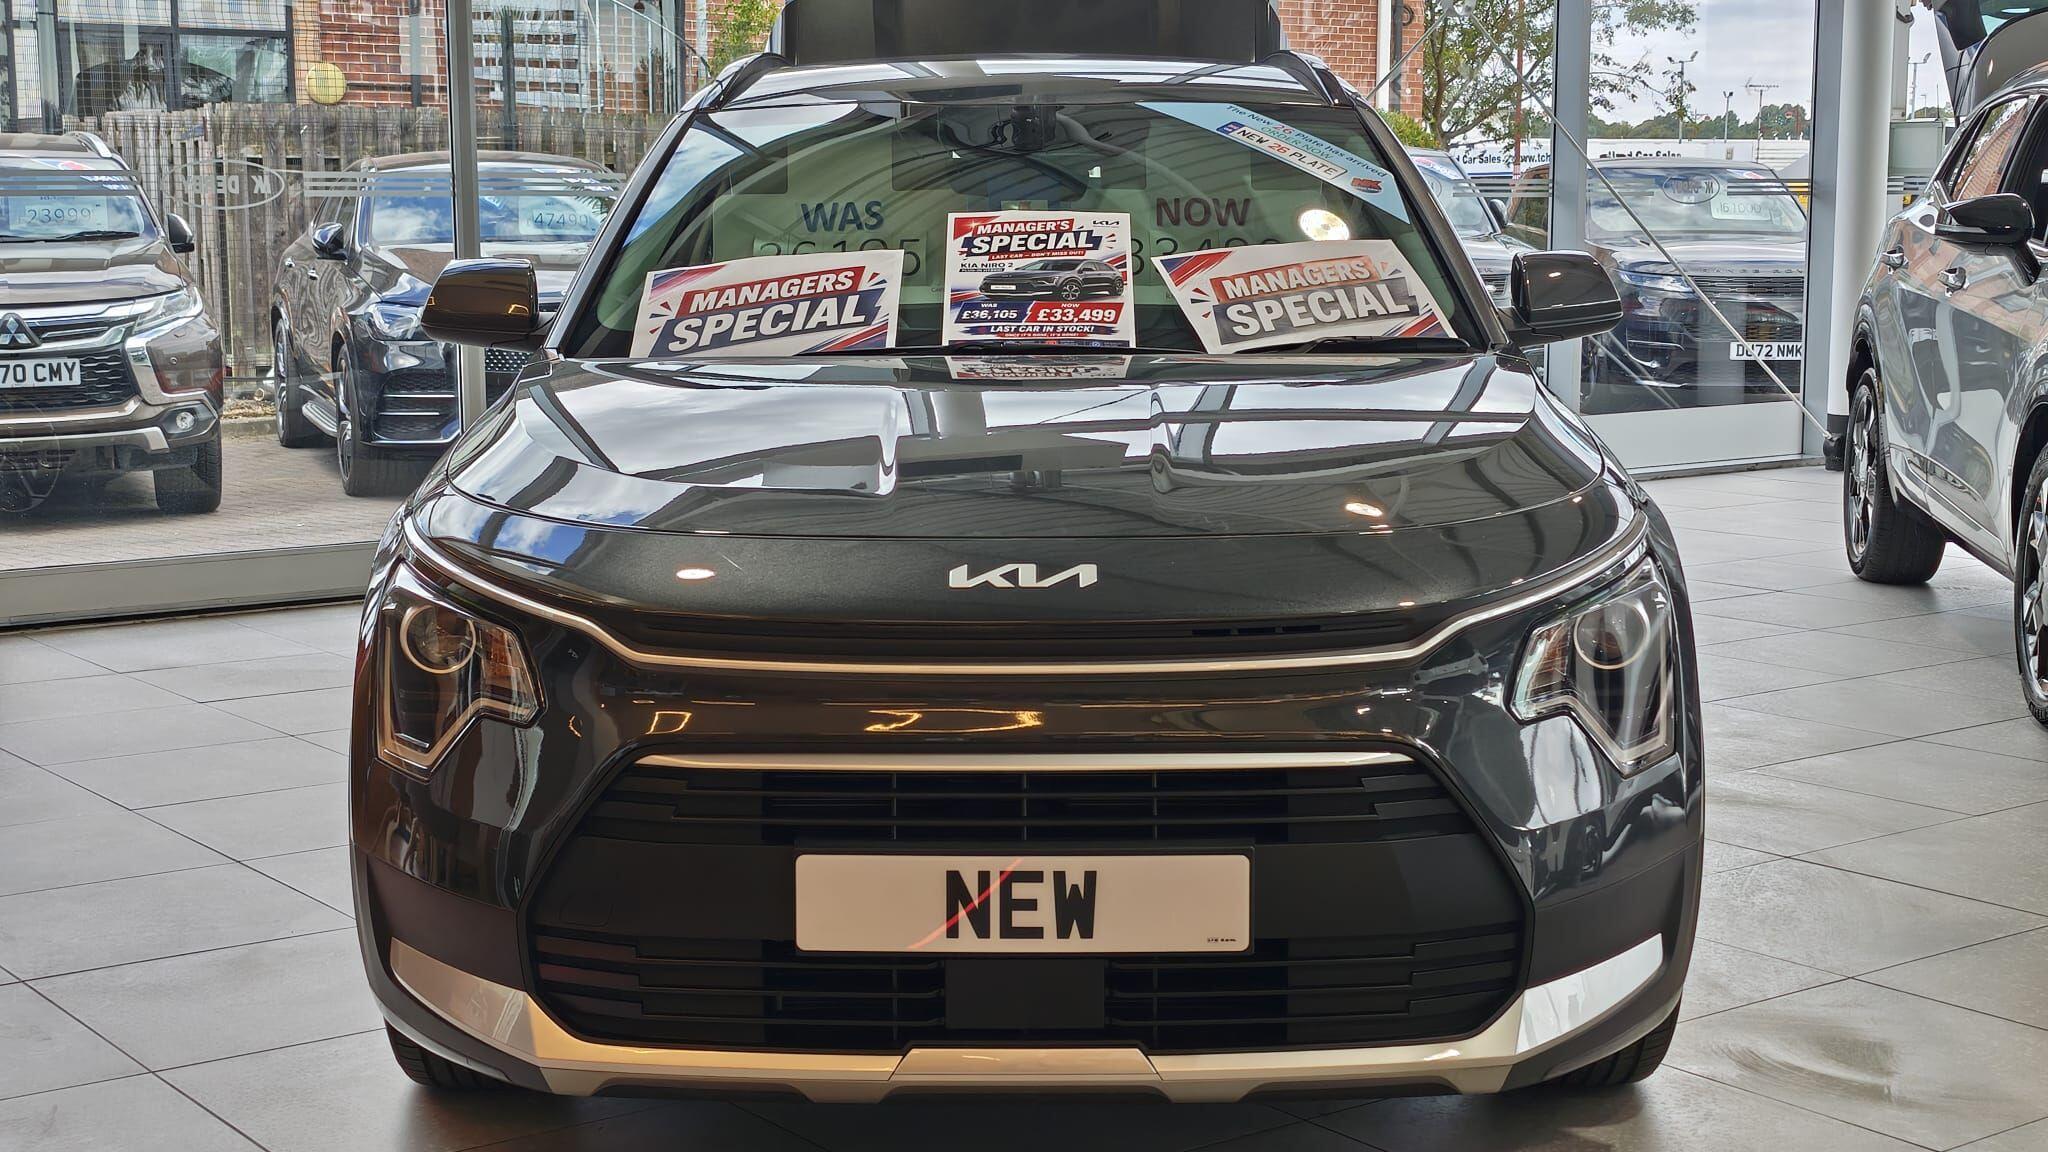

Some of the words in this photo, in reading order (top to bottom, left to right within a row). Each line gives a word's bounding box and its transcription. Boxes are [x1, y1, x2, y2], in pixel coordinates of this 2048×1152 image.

[1226, 105, 1246, 116] The
[1248, 113, 1273, 125] New
[1273, 125, 1293, 135] 26
[1295, 133, 1323, 147] Plate
[1324, 145, 1344, 157] has
[1345, 155, 1387, 178] arrived
[1236, 129, 1269, 144] NEW
[1268, 142, 1290, 154] 26
[1289, 151, 1339, 176] PLATE
[1260, 126, 1300, 146] ORDER
[1303, 144, 1335, 160] NOW
[1463, 154, 1477, 164] Car
[1478, 154, 1501, 164] Sales
[800, 200, 885, 233] WAS
[1155, 197, 1251, 227] NOW
[976, 220, 1070, 235] MANAGER'S
[971, 232, 1094, 255] SPECIAL
[688, 270, 855, 314] MANAGERS
[1223, 260, 1371, 300] MANAGERS
[667, 294, 867, 352] SPECIAL
[961, 309, 1018, 320] £36,105
[1037, 308, 1117, 323] £33,499
[1226, 283, 1410, 337] SPECIAL
[1056, 325, 1095, 333] STOCK!
[1777, 344, 1802, 358] NMK
[34, 361, 76, 383] CMY
[949, 563, 1098, 588] KIA
[946, 870, 1098, 940] NEW
